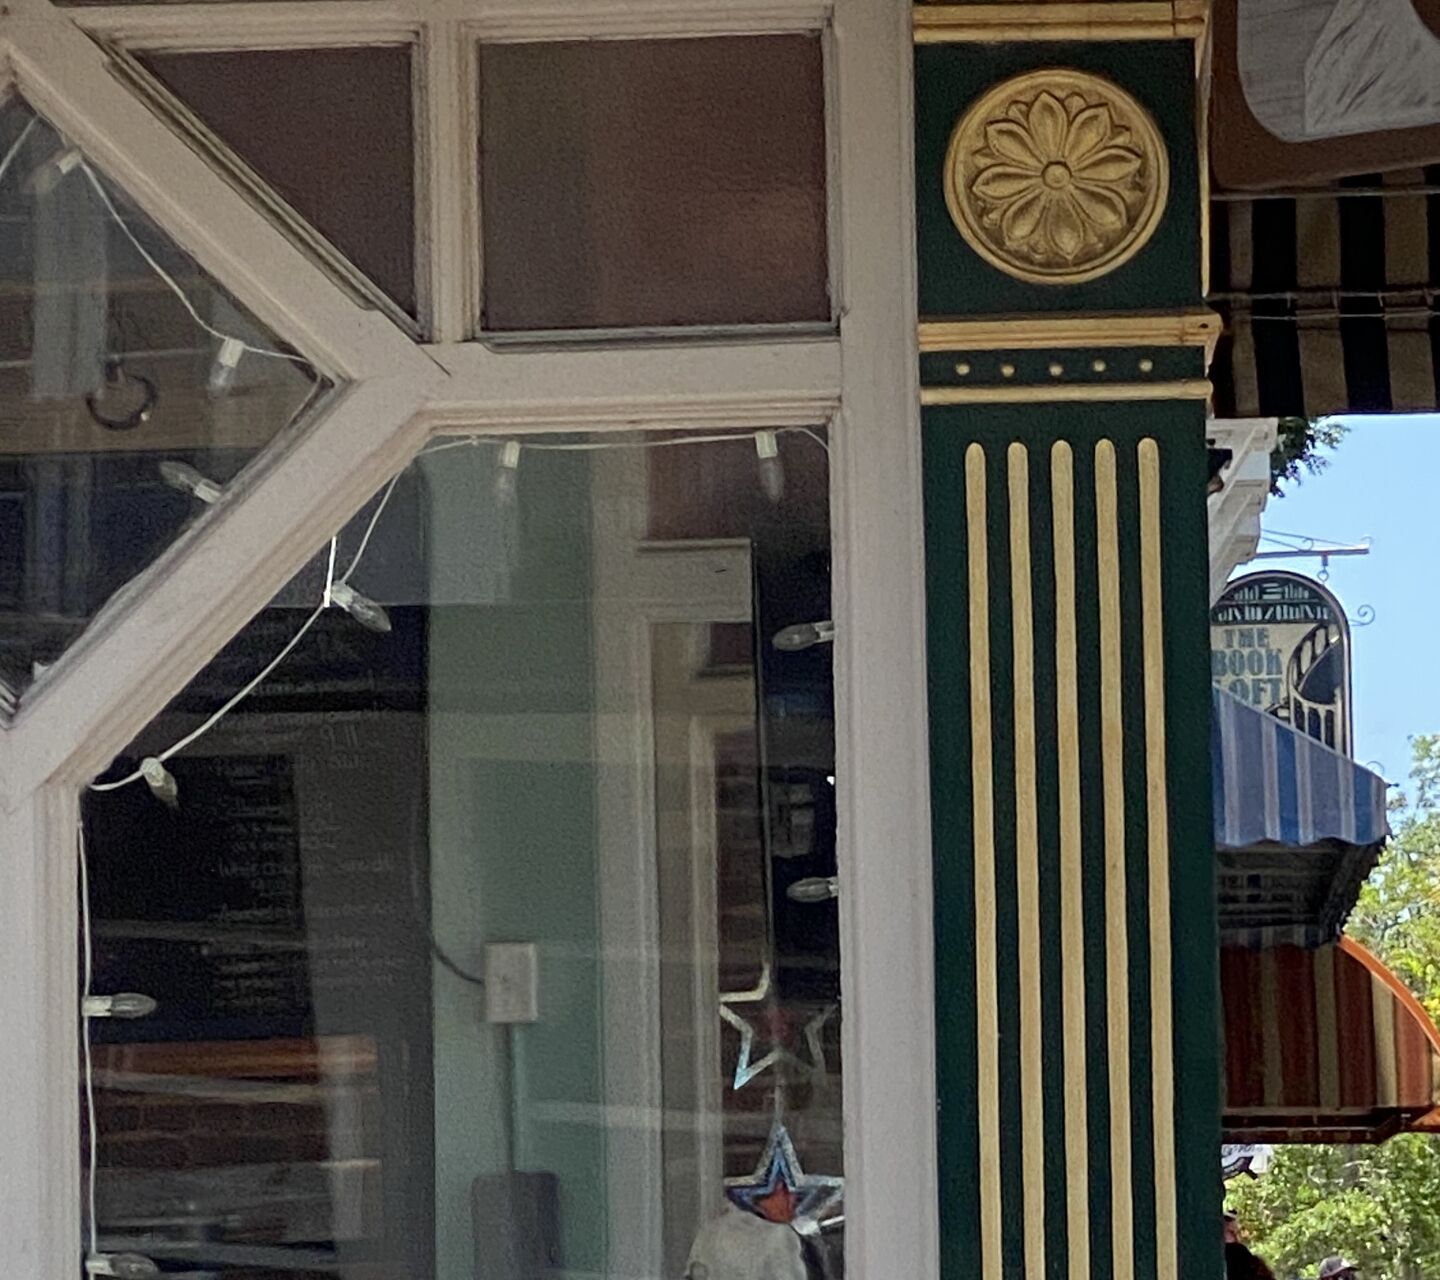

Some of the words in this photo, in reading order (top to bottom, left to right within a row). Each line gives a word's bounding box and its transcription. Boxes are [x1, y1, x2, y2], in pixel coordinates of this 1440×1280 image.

[1223, 628, 1270, 648] THE
[1211, 648, 1283, 677] BOOK
[1212, 677, 1283, 705] OFT
